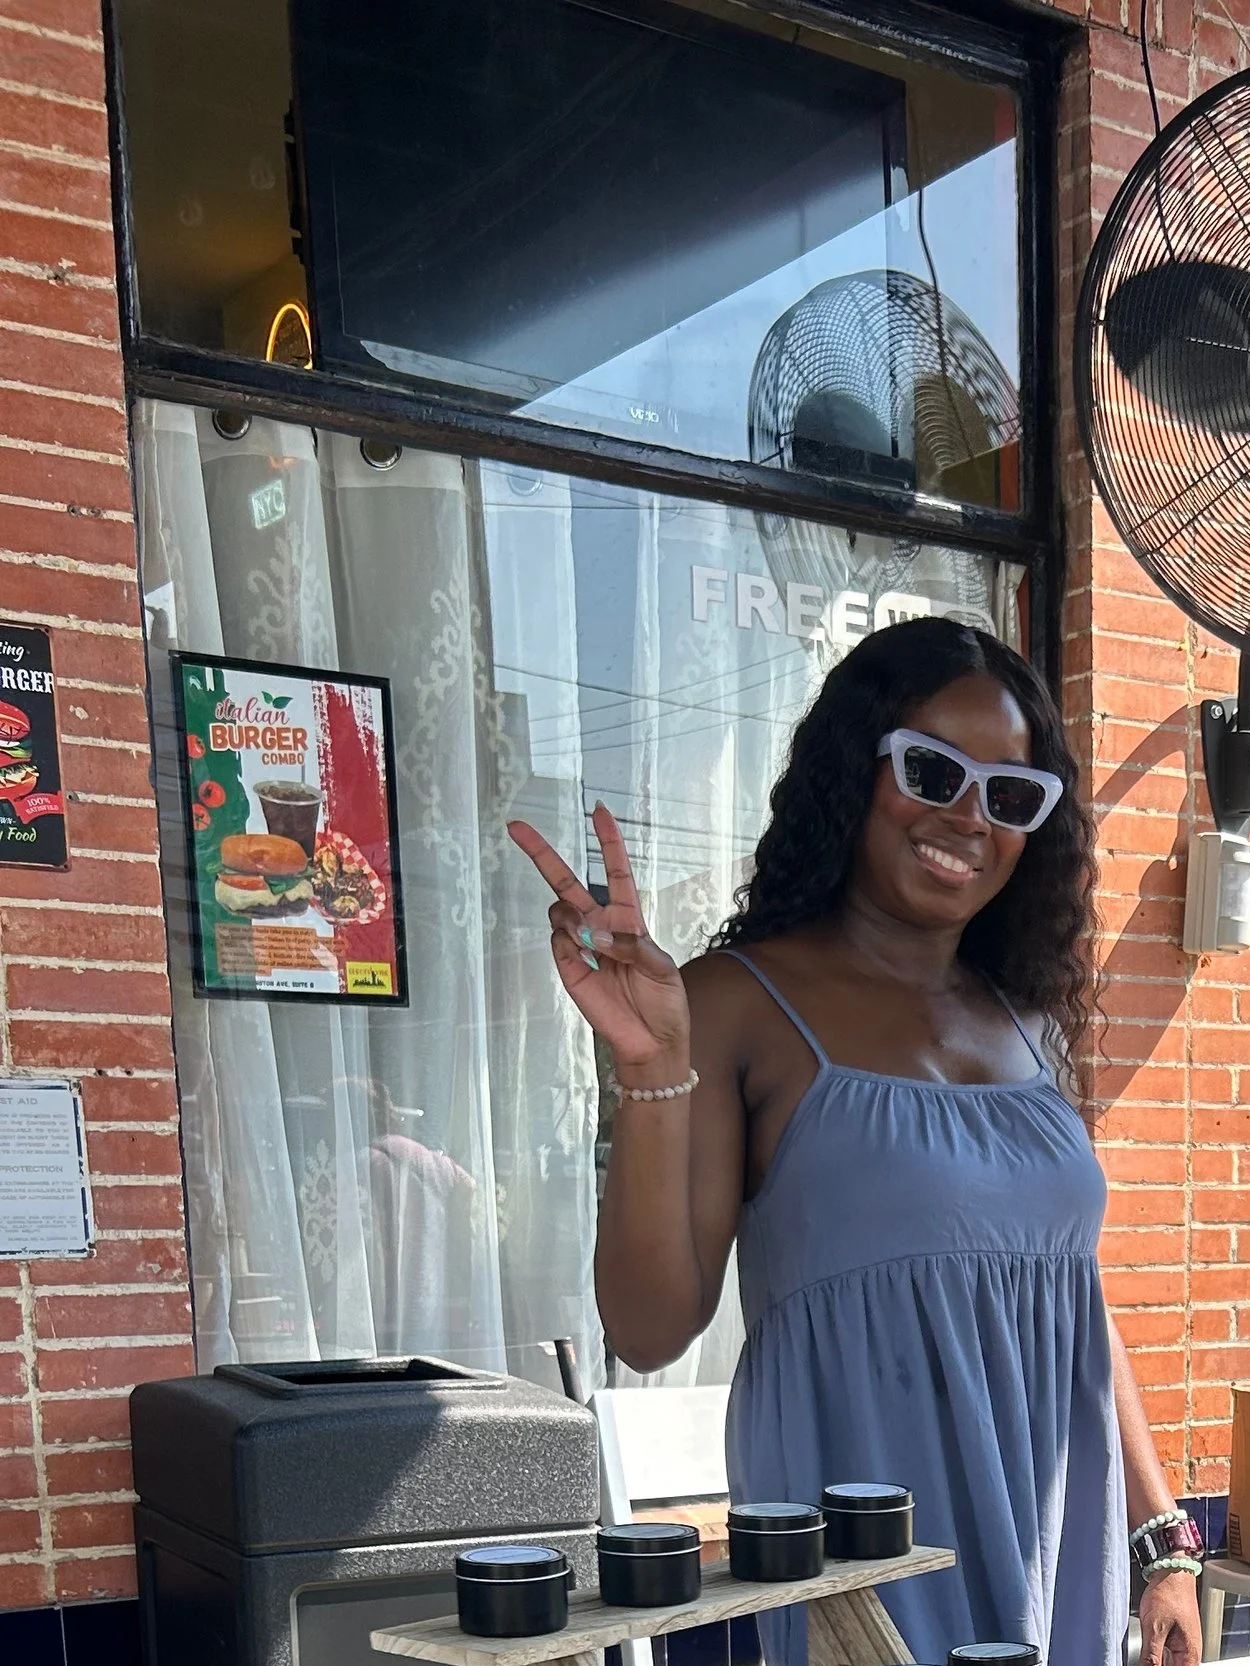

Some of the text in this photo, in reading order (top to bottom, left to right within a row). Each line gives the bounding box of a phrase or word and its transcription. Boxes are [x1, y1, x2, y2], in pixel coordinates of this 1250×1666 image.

[691, 565, 870, 646] FREE
[210, 725, 309, 751] BURGER
[262, 753, 305, 766] COMBO
[8, 827, 37, 842] Food
[17, 1097, 38, 1105] AID
